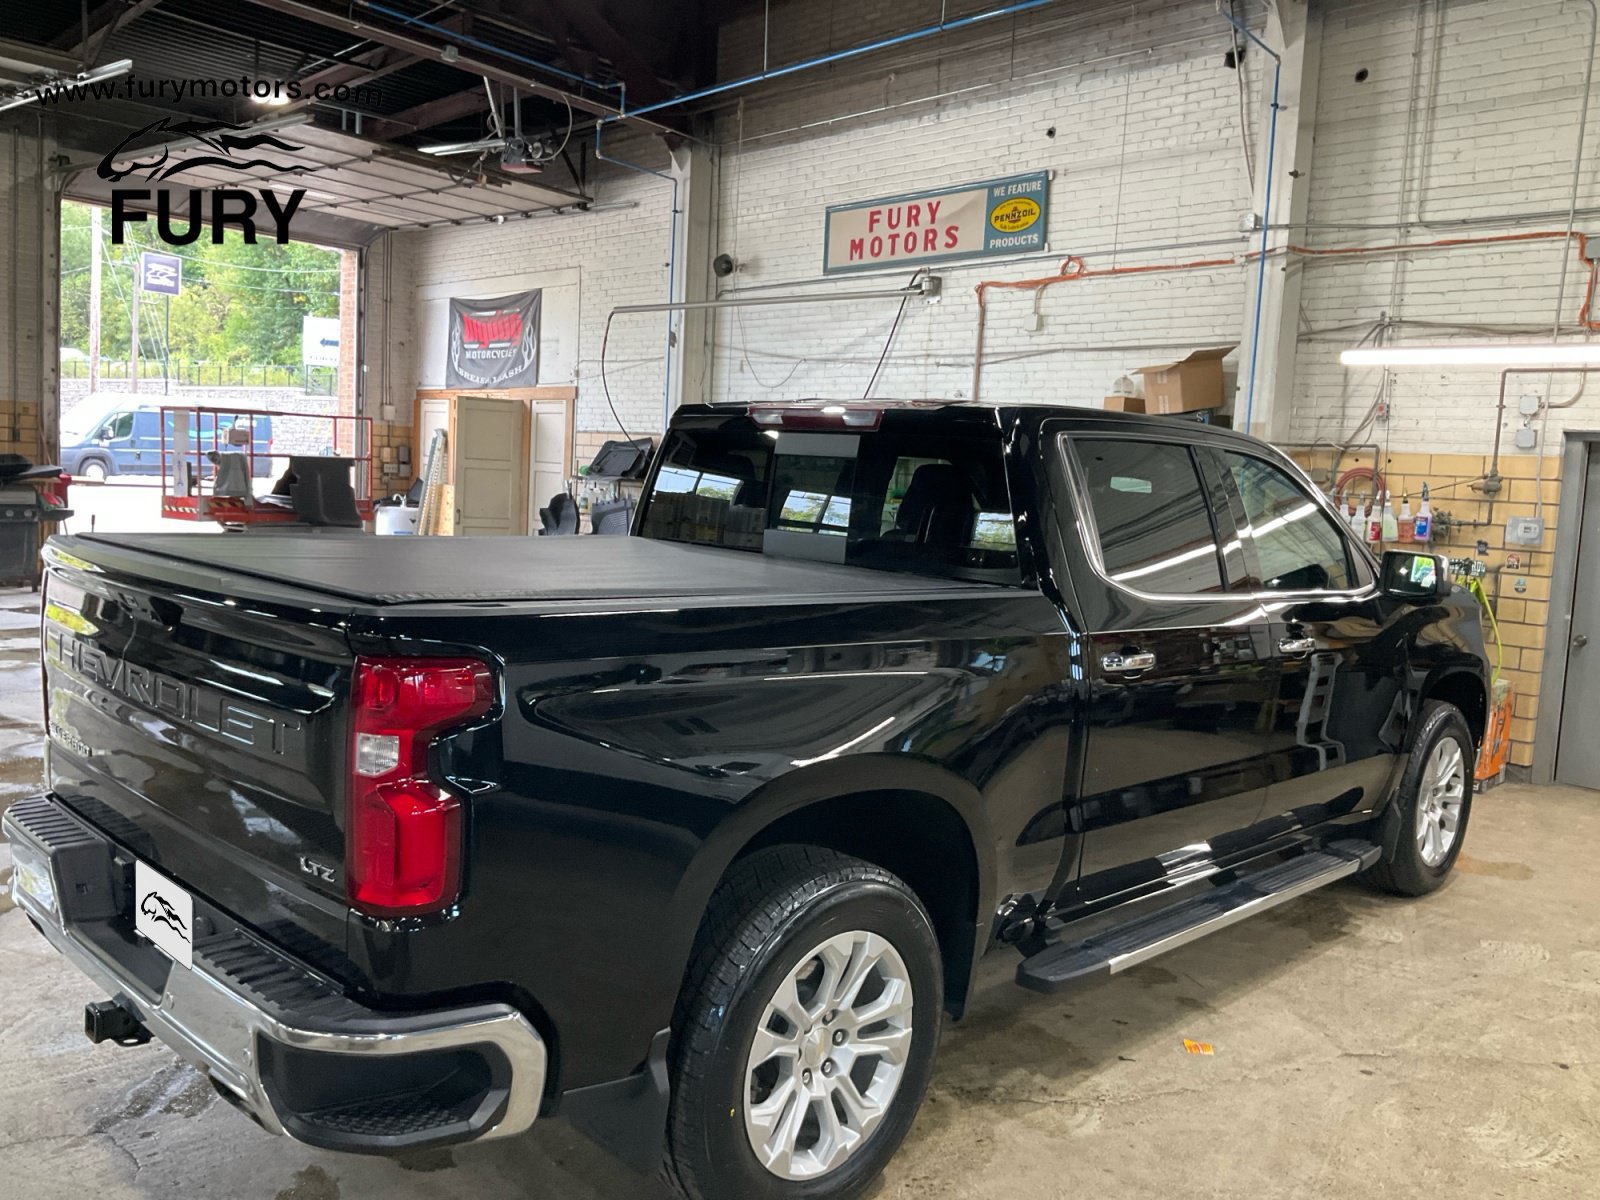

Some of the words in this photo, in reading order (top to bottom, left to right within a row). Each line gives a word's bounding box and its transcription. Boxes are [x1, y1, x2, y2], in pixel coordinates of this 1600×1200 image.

[993, 186, 1006, 199] WE
[1007, 180, 1042, 195] FEATURE
[868, 200, 941, 233] FURY
[994, 208, 1036, 223] PENNZOIL
[849, 225, 959, 260] MOTORS
[989, 233, 1039, 249] PRODUCTS
[45, 626, 301, 755] CHEVROLET
[300, 856, 336, 883] LTZ
